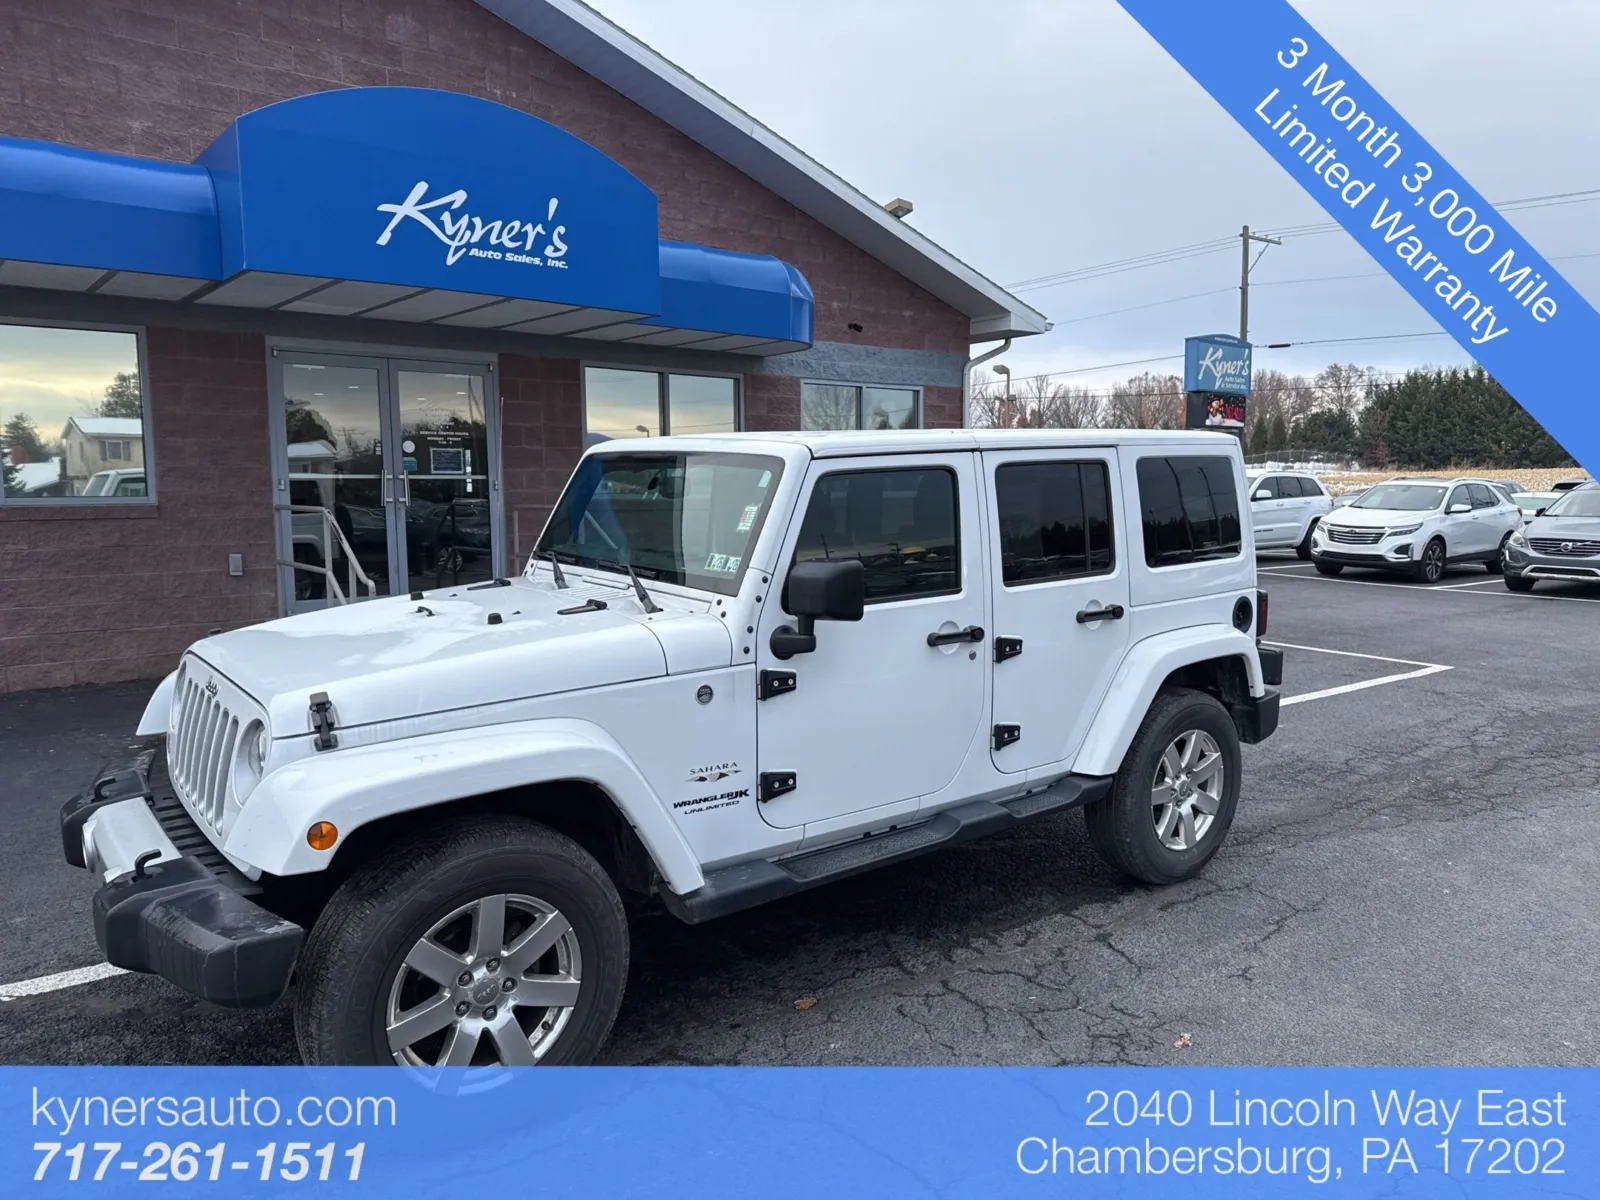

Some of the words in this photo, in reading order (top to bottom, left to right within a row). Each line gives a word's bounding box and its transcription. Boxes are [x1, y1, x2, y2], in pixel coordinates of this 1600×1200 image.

[376, 181, 569, 266] Kyner's
[468, 247, 502, 260] Auto
[504, 252, 544, 266] Sales,
[546, 257, 569, 269] Inc.
[1198, 347, 1249, 390] Kyner's
[689, 761, 738, 776] SAHARA
[684, 800, 740, 815] UNLIMITED
